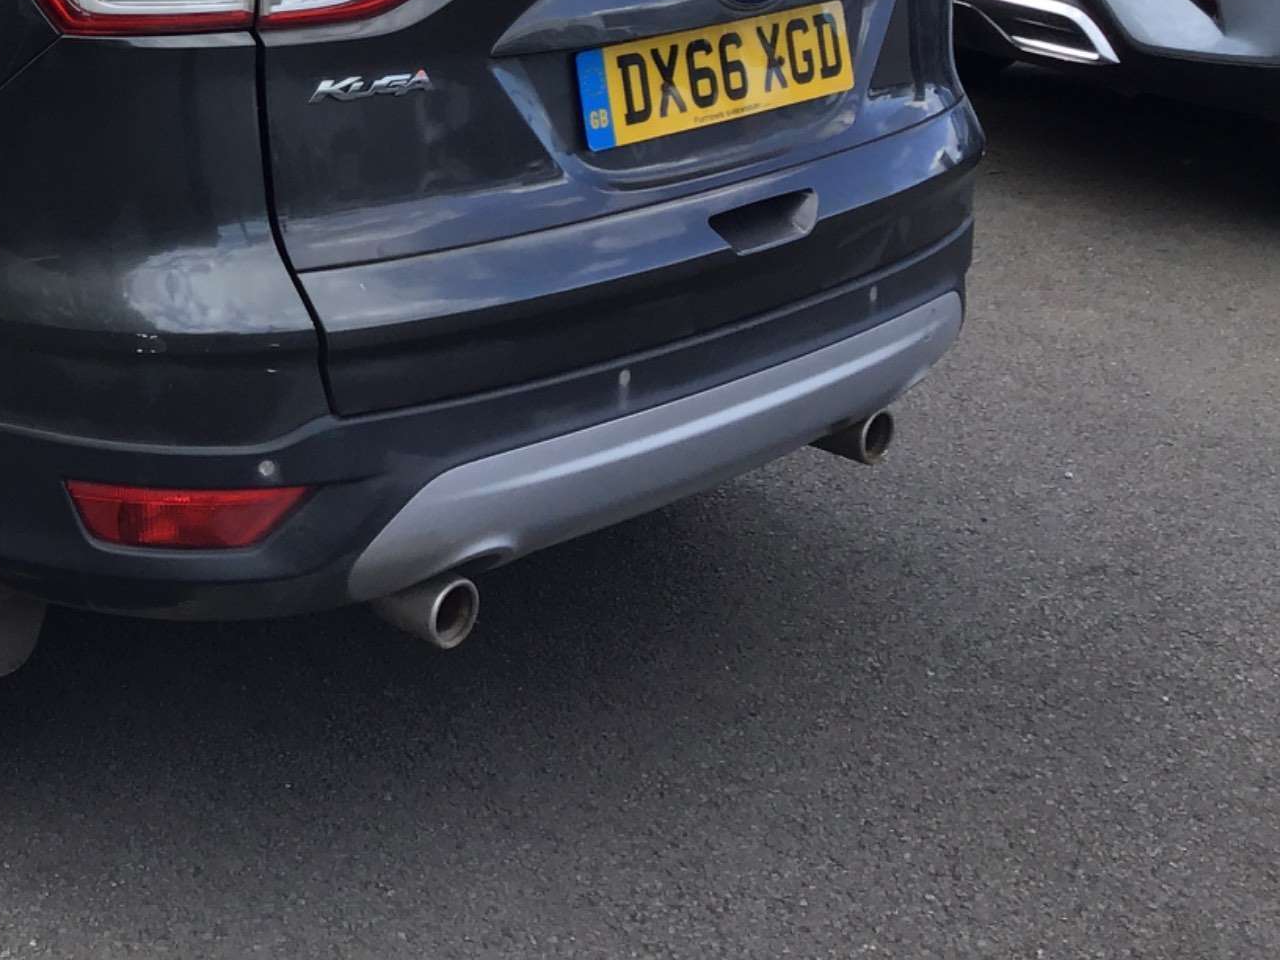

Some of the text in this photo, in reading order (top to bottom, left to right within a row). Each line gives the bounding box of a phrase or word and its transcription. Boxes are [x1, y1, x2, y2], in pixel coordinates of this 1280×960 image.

[309, 69, 433, 103] KUGA
[616, 12, 843, 126] DX66 XGD
[589, 108, 608, 130] GB
